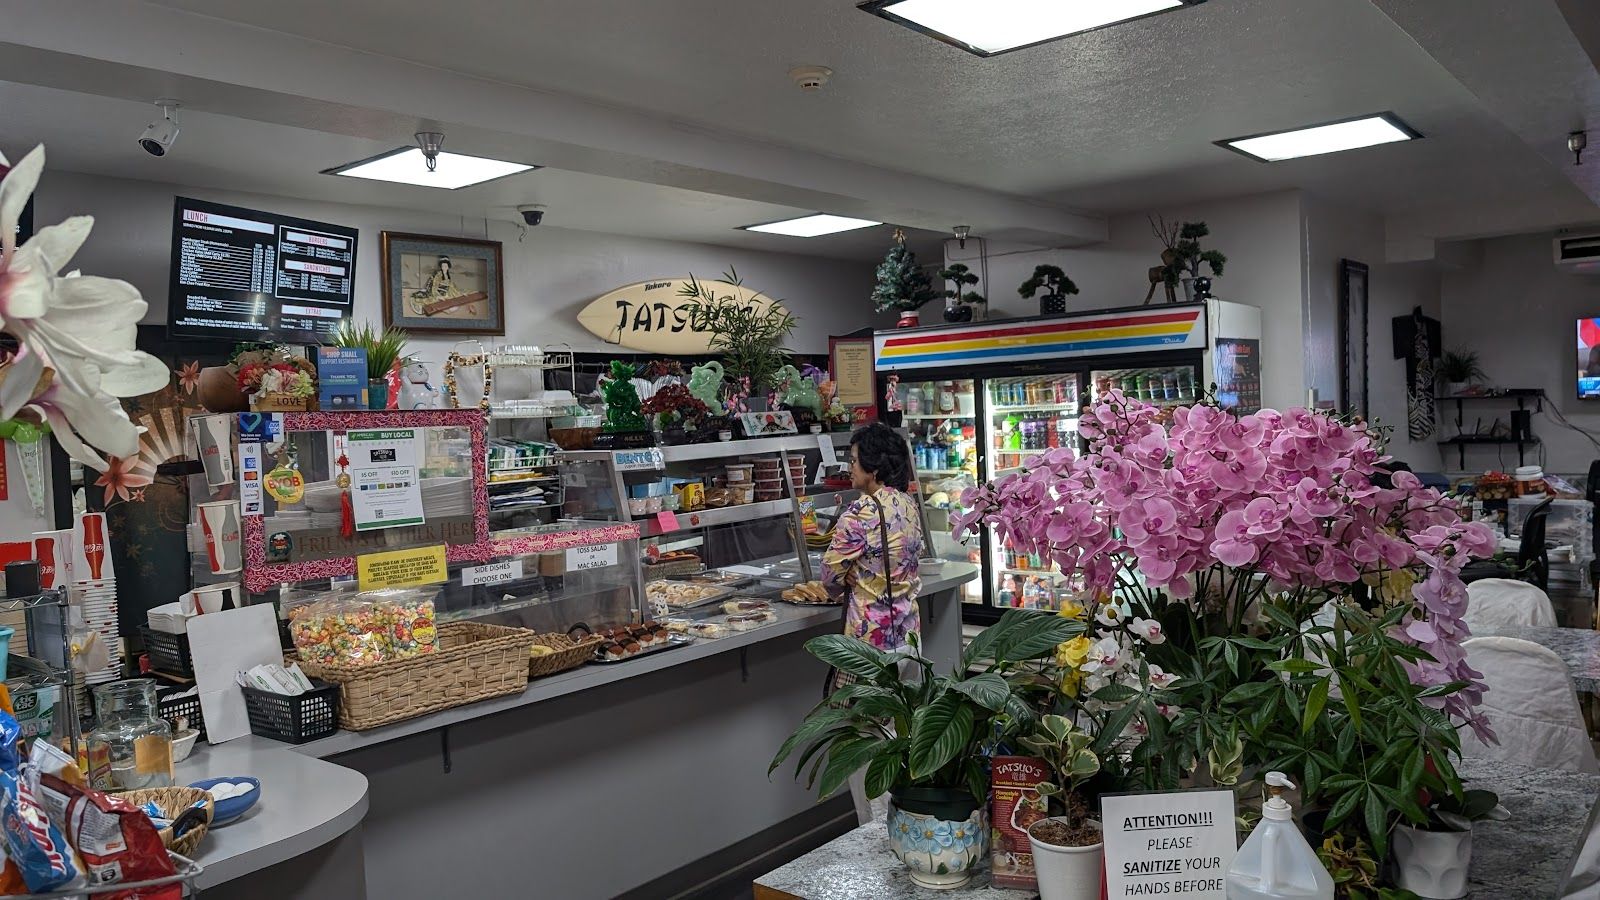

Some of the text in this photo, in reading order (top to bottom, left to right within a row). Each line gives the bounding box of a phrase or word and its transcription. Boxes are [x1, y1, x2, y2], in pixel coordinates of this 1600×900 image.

[187, 211, 208, 222] LUNCH
[341, 350, 358, 358] SMALL
[276, 397, 302, 406] LOVE
[268, 477, 300, 489] BYOB
[577, 544, 608, 554] TOSS SALAD
[474, 562, 510, 574] SIDE DISHES
[578, 560, 608, 570] MAC SALAD
[474, 572, 512, 584] CHOOSE ONE
[16, 701, 34, 710] tac
[996, 762, 1042, 777] TATSUO'S
[1123, 812, 1213, 829] ATTENTION!!!
[1148, 836, 1193, 850] PLEASE
[1123, 857, 1221, 874] SANITIZE YOUR
[1125, 878, 1224, 896] HANDS BEFORE
